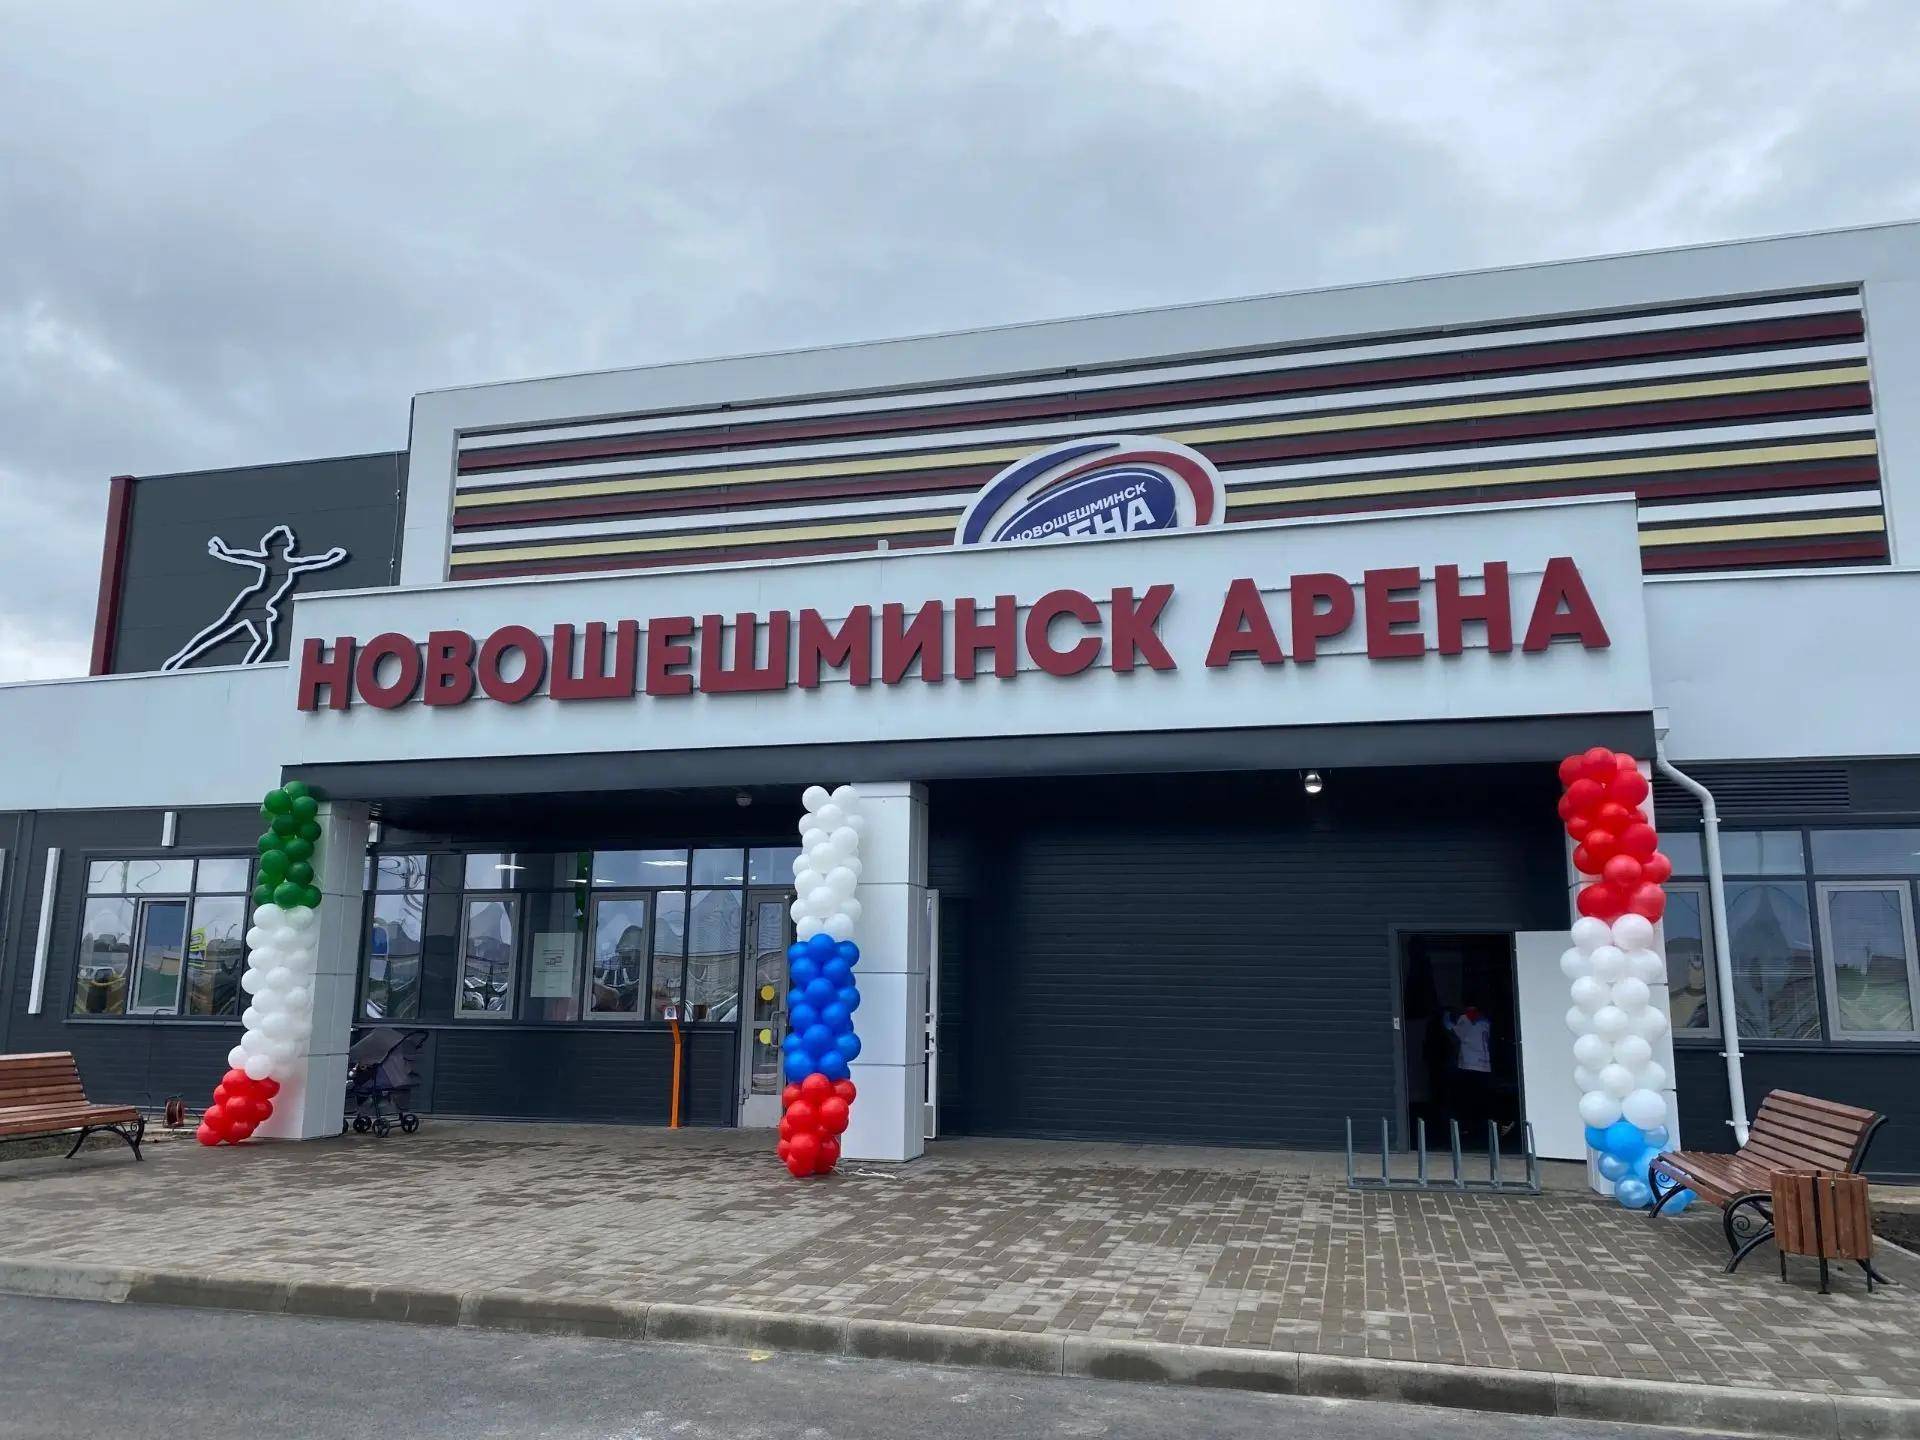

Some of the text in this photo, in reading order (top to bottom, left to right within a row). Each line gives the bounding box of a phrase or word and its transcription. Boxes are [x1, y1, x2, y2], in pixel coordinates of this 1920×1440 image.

[1045, 497, 1156, 537] ЕНА
[298, 556, 1611, 711] НОВОШЕШМИНСК АРЕНА
